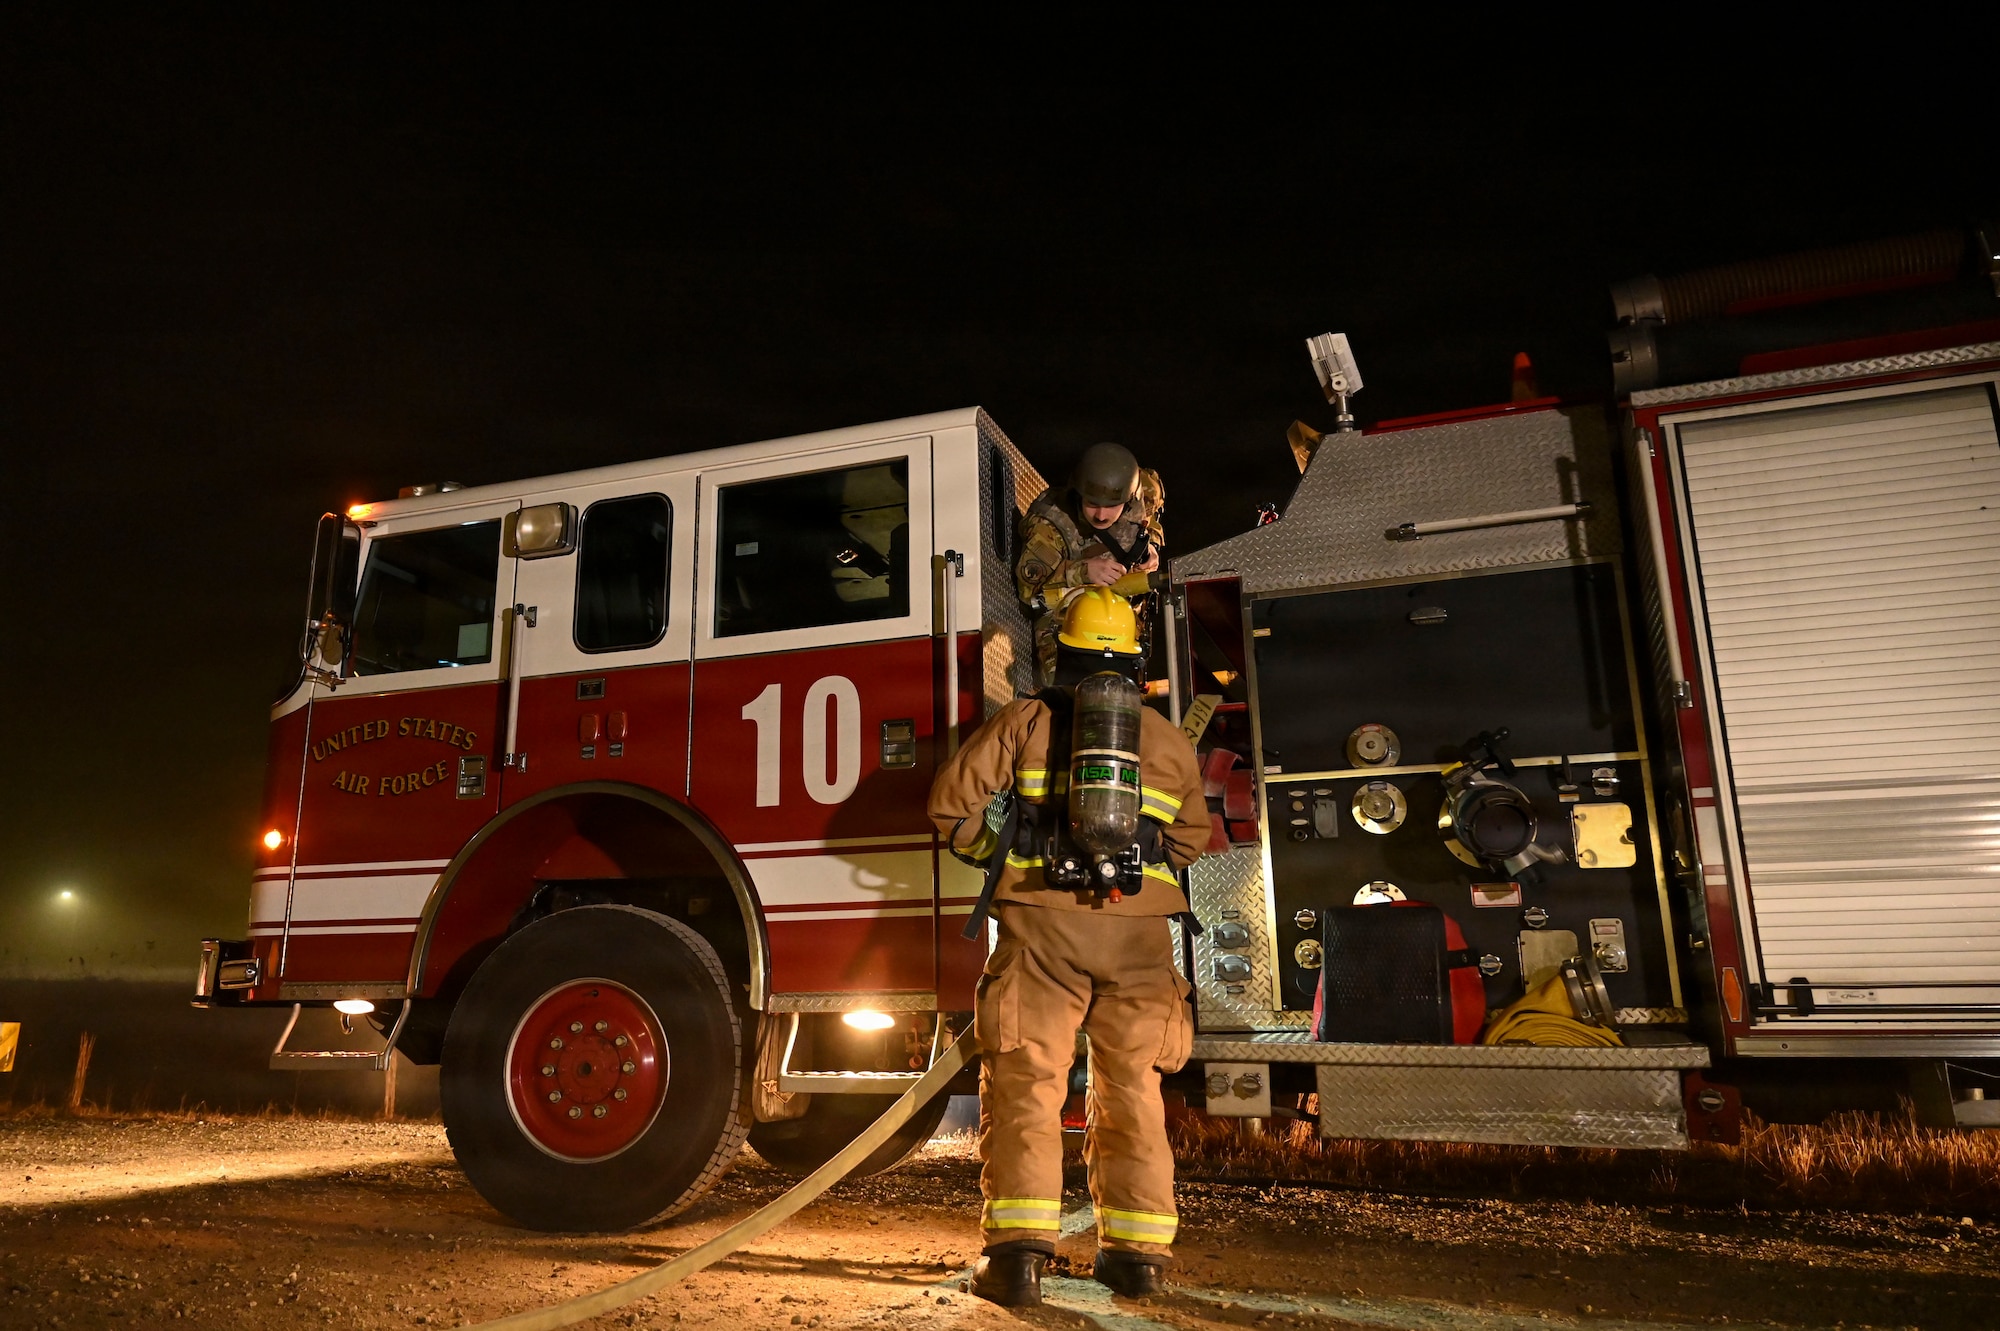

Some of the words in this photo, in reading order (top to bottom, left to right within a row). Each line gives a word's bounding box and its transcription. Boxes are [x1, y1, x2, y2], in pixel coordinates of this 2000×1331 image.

[312, 719, 390, 762] UNITED
[398, 717, 478, 751] STATES
[741, 675, 862, 808] 10
[332, 770, 370, 795] AIR
[378, 759, 450, 796] FORCE
